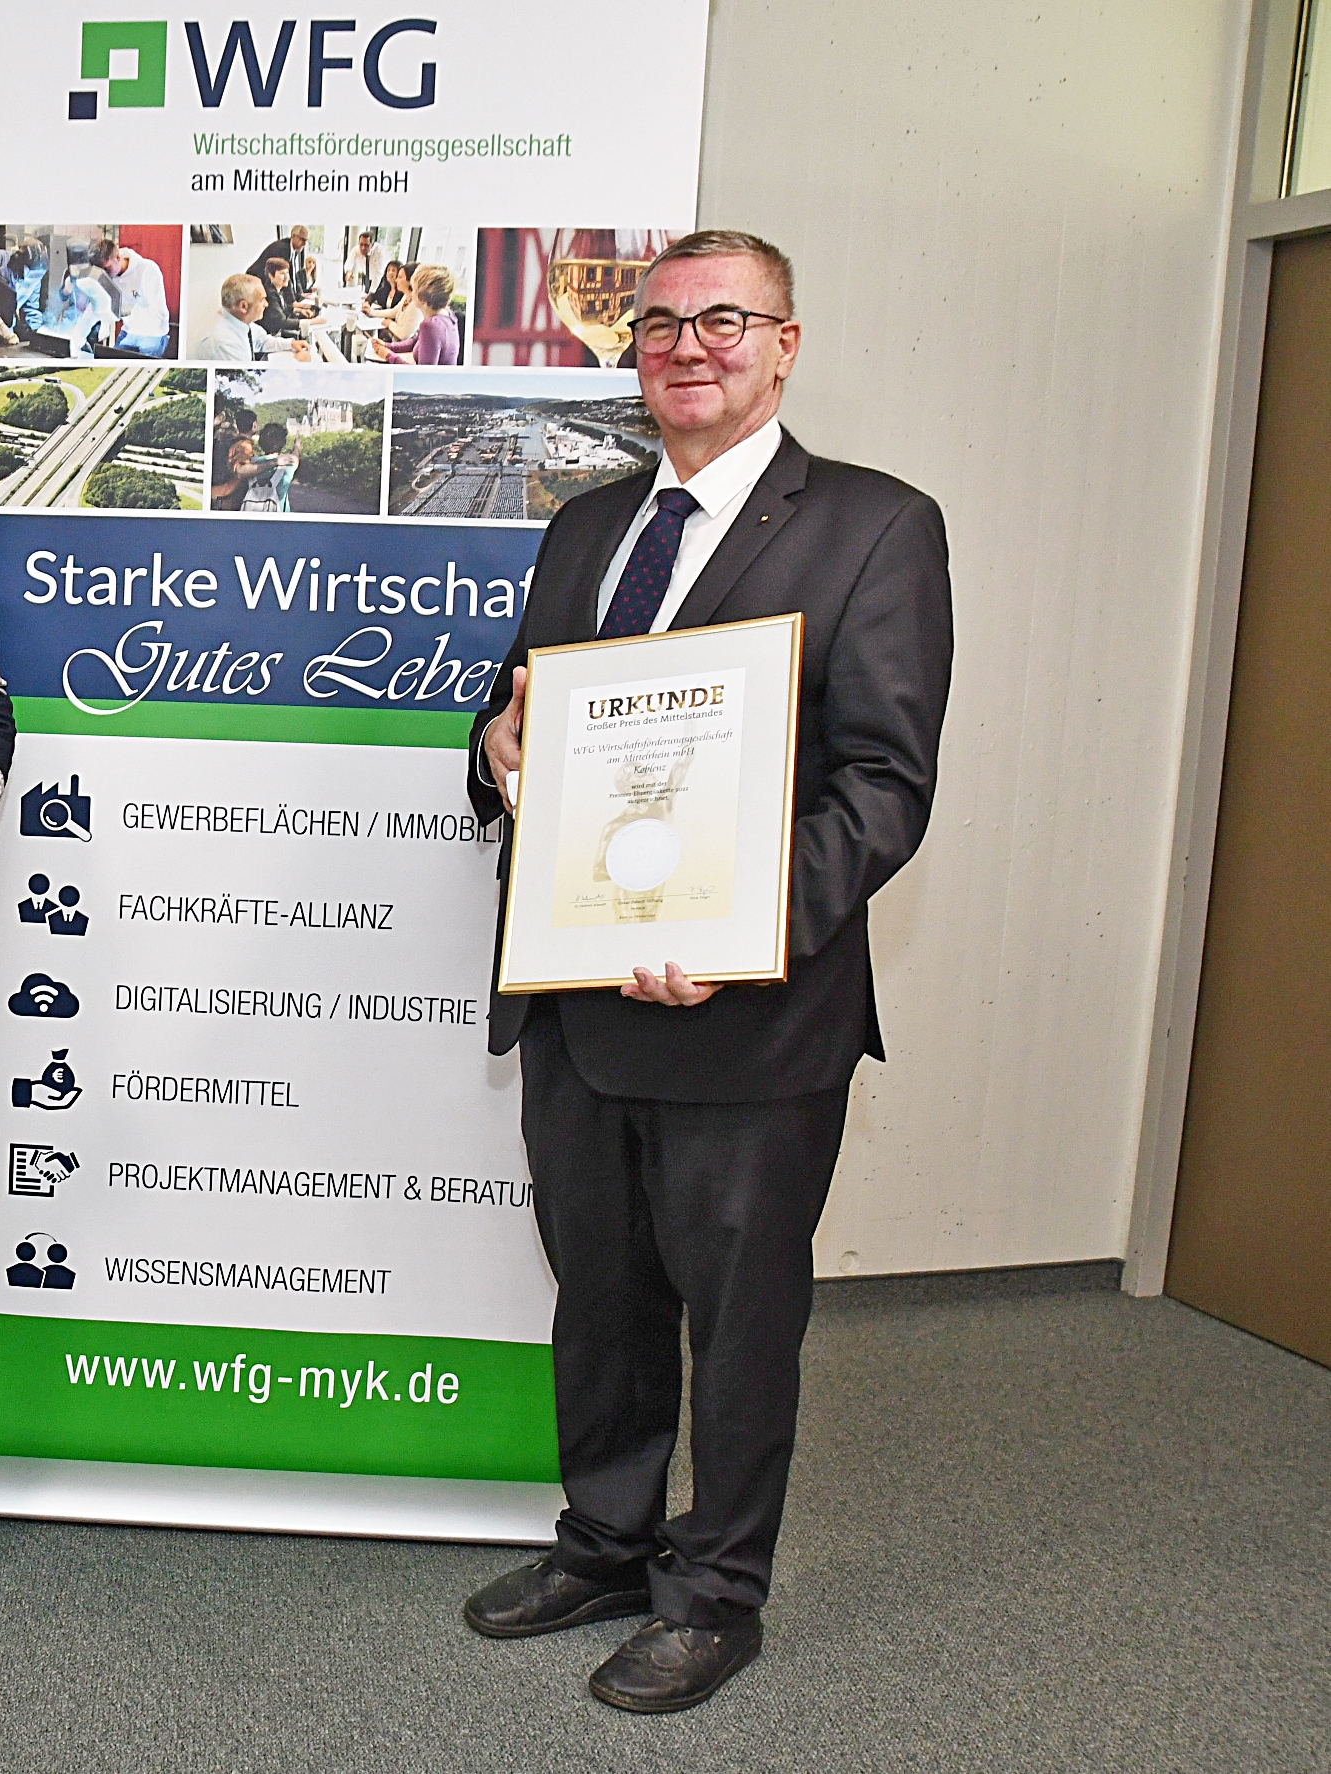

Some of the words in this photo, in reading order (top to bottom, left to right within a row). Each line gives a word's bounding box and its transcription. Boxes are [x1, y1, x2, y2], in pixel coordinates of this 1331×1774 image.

[183, 18, 438, 110] WFG
[192, 132, 573, 162] Wirtschaftsförderungsgesellschaft
[190, 174, 225, 192] am
[232, 169, 350, 193] Mittelrhein
[357, 171, 409, 194] mbH
[23, 550, 218, 609] Starke
[62, 620, 284, 716] Gutes
[588, 684, 725, 720] URKUNDE
[586, 722, 617, 732] Großer
[619, 718, 641, 728] Preis
[642, 716, 658, 726] des
[660, 709, 724, 724] Mittelstandes
[573, 745, 596, 755] WFG
[606, 756, 620, 765] am
[623, 748, 670, 763] Mittelrhein
[633, 763, 667, 774] Koblenz
[122, 802, 359, 838] GEWERBEFLÄCHEN
[367, 811, 379, 838] /
[118, 893, 394, 930] FACHKRÄFTE-ALLIANZ
[115, 984, 322, 1019] DIGITALISIERUNG
[329, 993, 342, 1020] /
[348, 994, 478, 1025] INDUSTRIE
[112, 1073, 300, 1108] FÖRDERMITTEL
[108, 1162, 397, 1200] PROJEKTMANAGEMENT
[403, 1175, 422, 1202] &
[104, 1256, 392, 1295] WISSENSMANAGEMENT
[65, 1353, 460, 1409] www.wfg-myk.de
